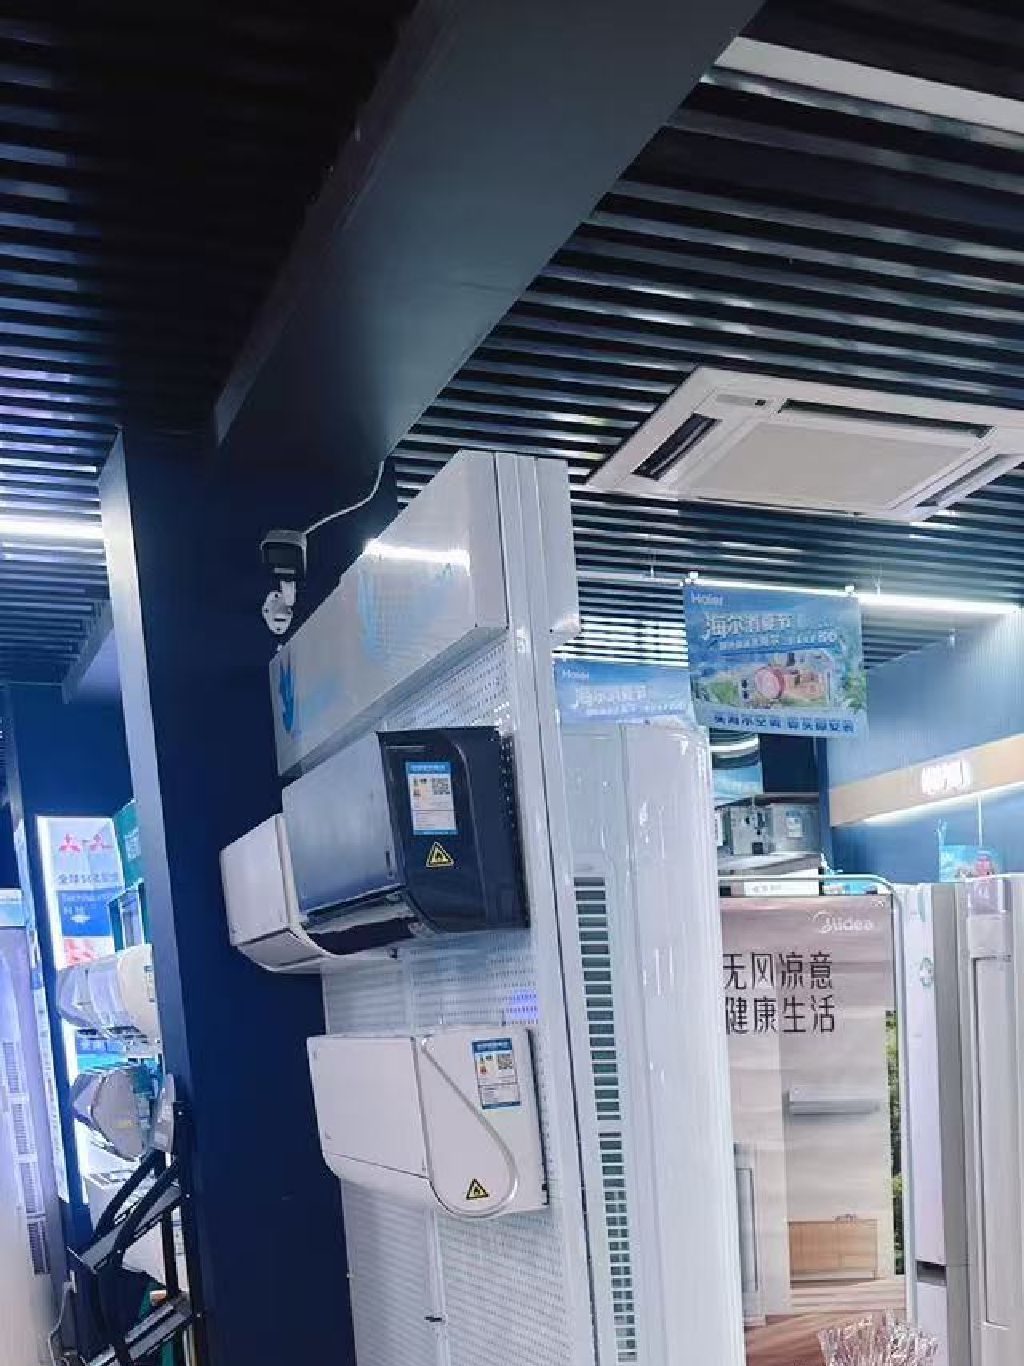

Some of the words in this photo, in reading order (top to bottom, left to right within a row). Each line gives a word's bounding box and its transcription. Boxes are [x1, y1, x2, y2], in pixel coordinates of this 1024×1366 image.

[722, 952, 833, 990] 无风凉意
[724, 995, 835, 1034] 健康生活
